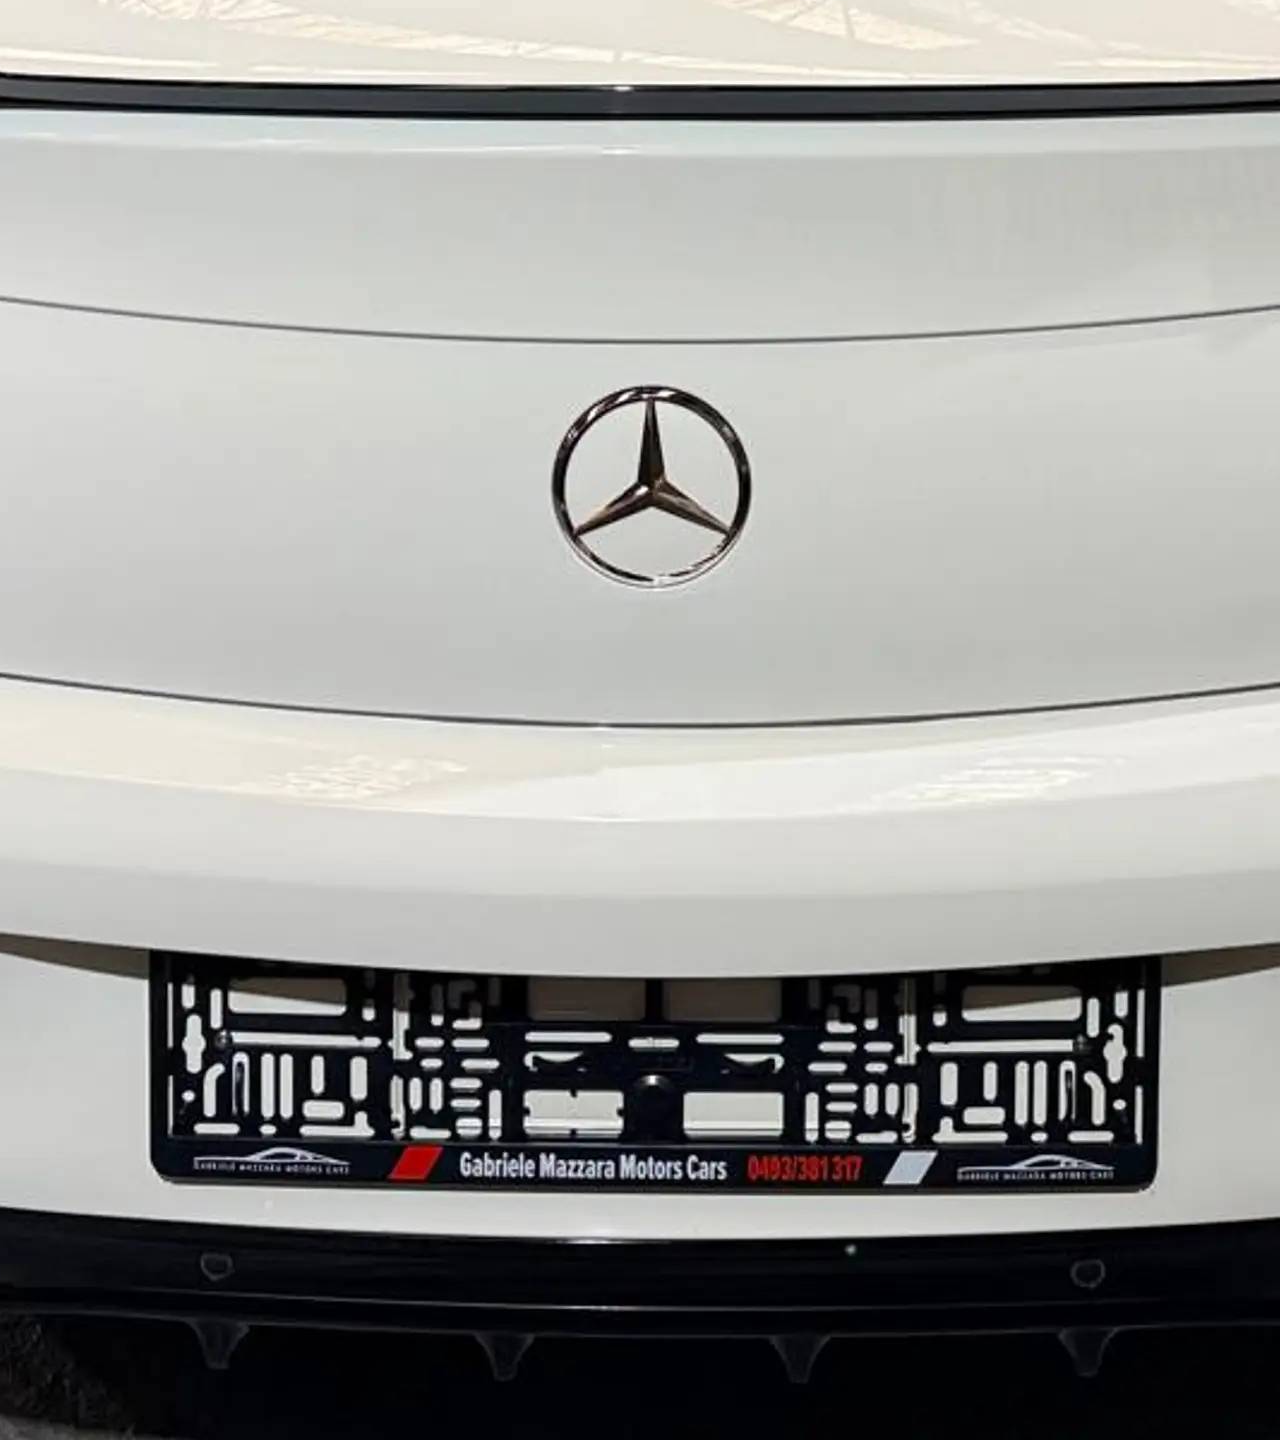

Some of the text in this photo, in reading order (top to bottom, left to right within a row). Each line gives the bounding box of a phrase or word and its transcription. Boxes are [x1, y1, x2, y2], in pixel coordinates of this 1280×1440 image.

[459, 1151, 535, 1179] Gabriele
[539, 1152, 615, 1180] Mazzara
[620, 1154, 683, 1181] Motors
[687, 1154, 727, 1181] Cars
